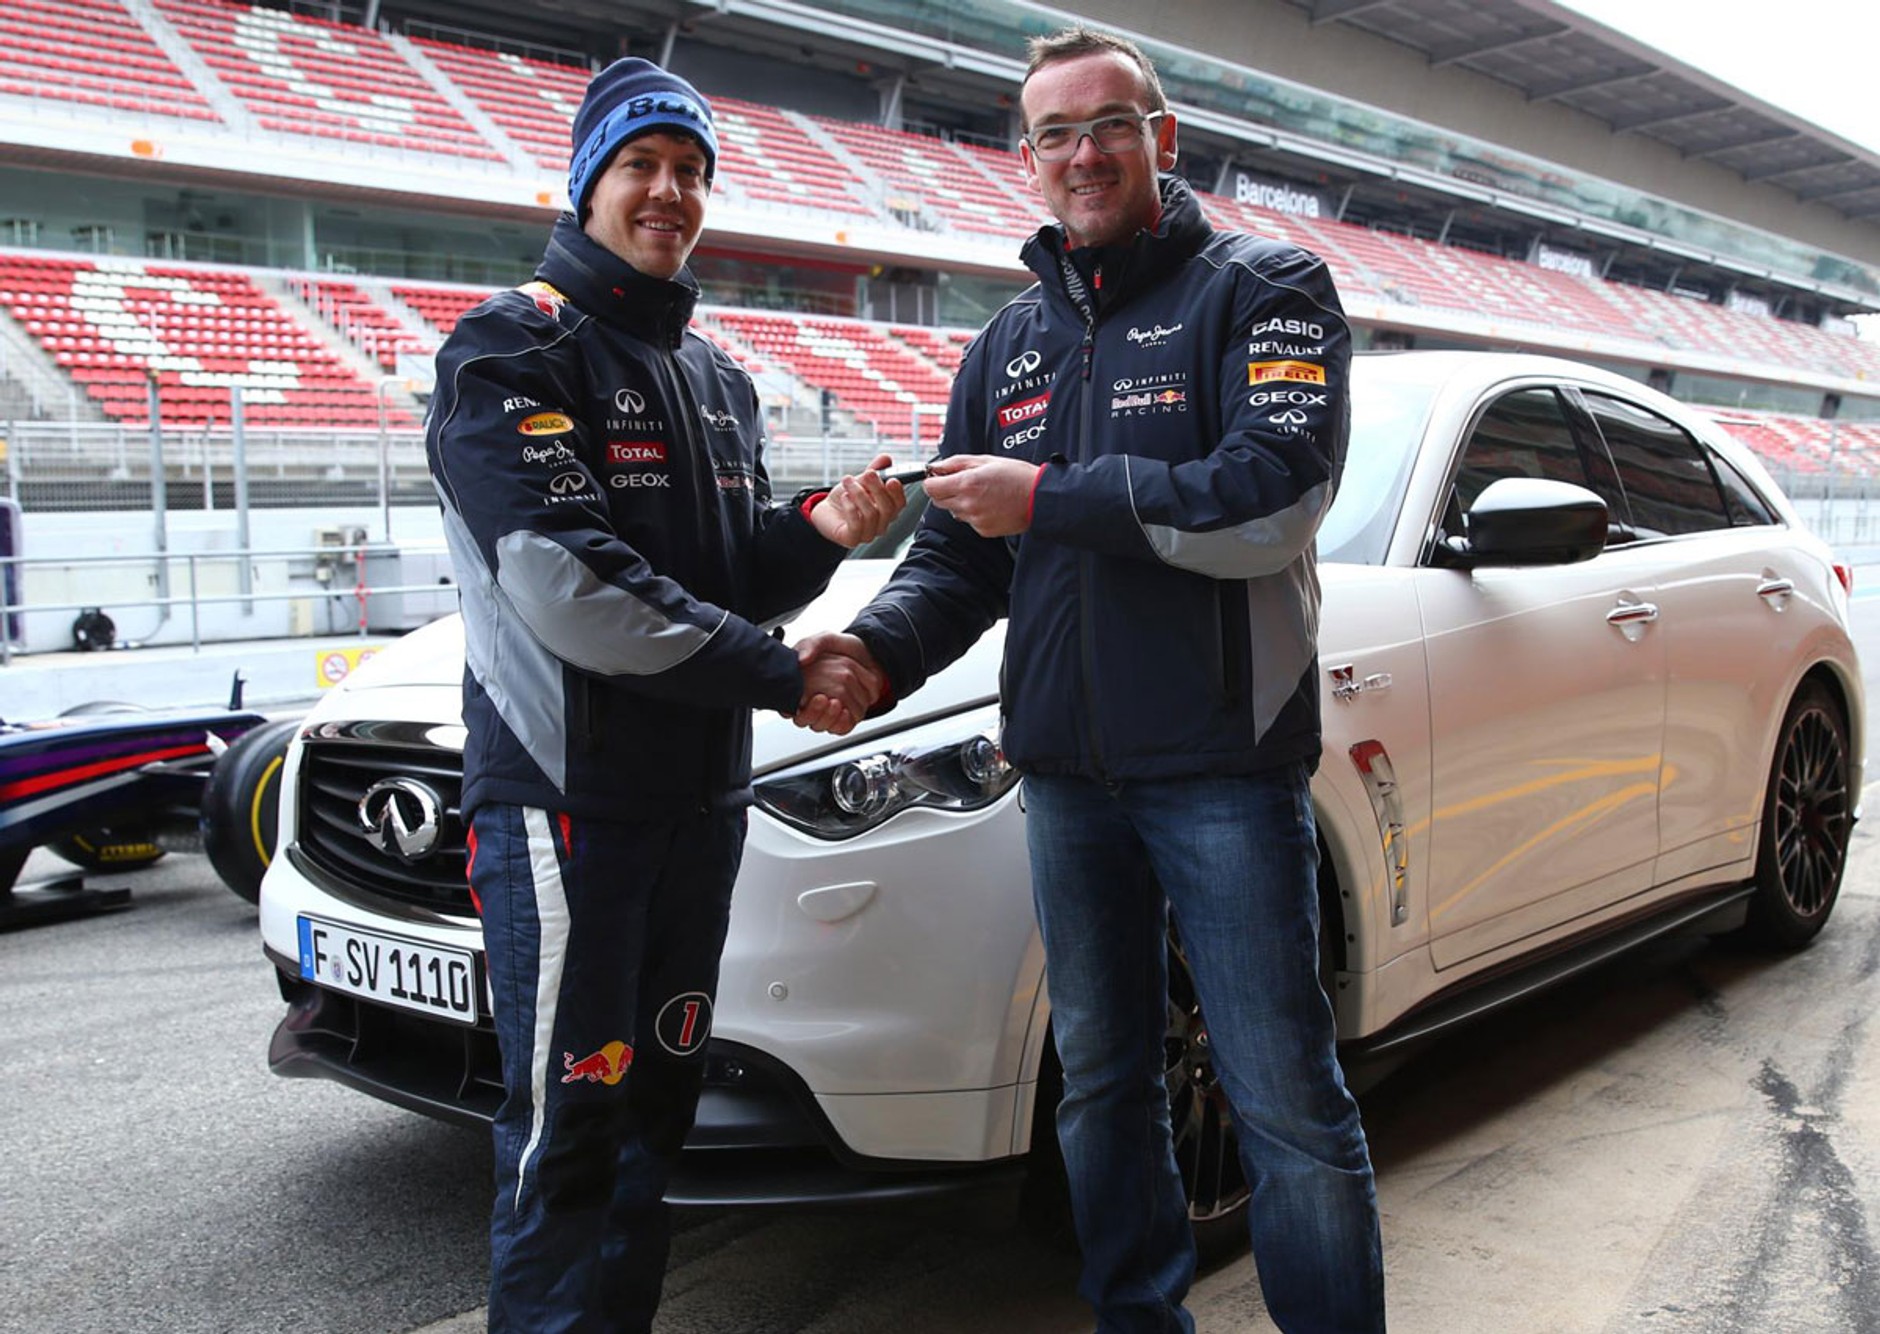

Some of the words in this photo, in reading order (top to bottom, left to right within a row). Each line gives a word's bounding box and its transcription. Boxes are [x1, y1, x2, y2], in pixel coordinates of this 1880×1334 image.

[1236, 172, 1319, 218] Barcelona
[1252, 318, 1324, 340] CASIO
[1248, 341, 1325, 355] RENAULT
[995, 371, 1056, 399] INFINITI
[1249, 391, 1328, 406] GEOX
[1111, 404, 1187, 418] RACING
[606, 420, 663, 431] INFINITI
[610, 445, 664, 459] TOTAL
[610, 473, 670, 489] GEOX
[313, 930, 327, 975] F
[347, 938, 380, 992] SV
[389, 949, 469, 1013] 1110
[679, 1002, 700, 1046] 1
